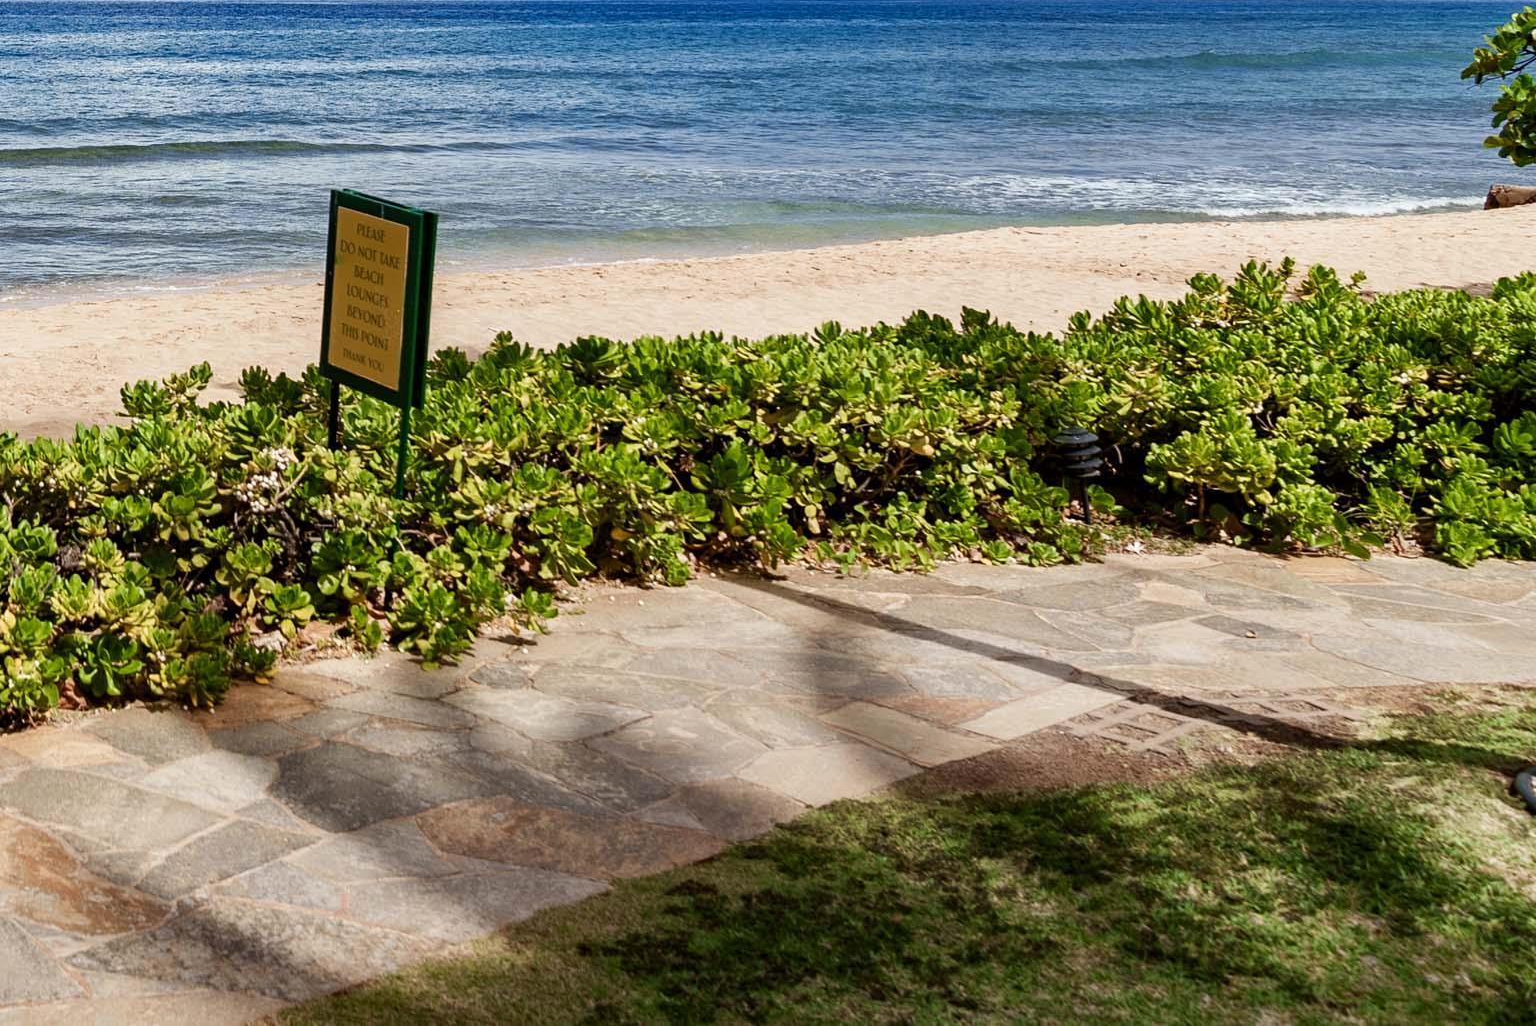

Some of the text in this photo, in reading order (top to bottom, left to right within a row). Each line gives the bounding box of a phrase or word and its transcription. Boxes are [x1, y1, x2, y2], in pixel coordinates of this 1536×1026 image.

[357, 223, 385, 243] PLEASE
[340, 239, 401, 270] DO NOT TAKE
[353, 264, 384, 286] BEACH
[347, 304, 386, 328] BEYOND
[341, 322, 389, 351] THIS POINT
[343, 348, 384, 373] THANK YOU
